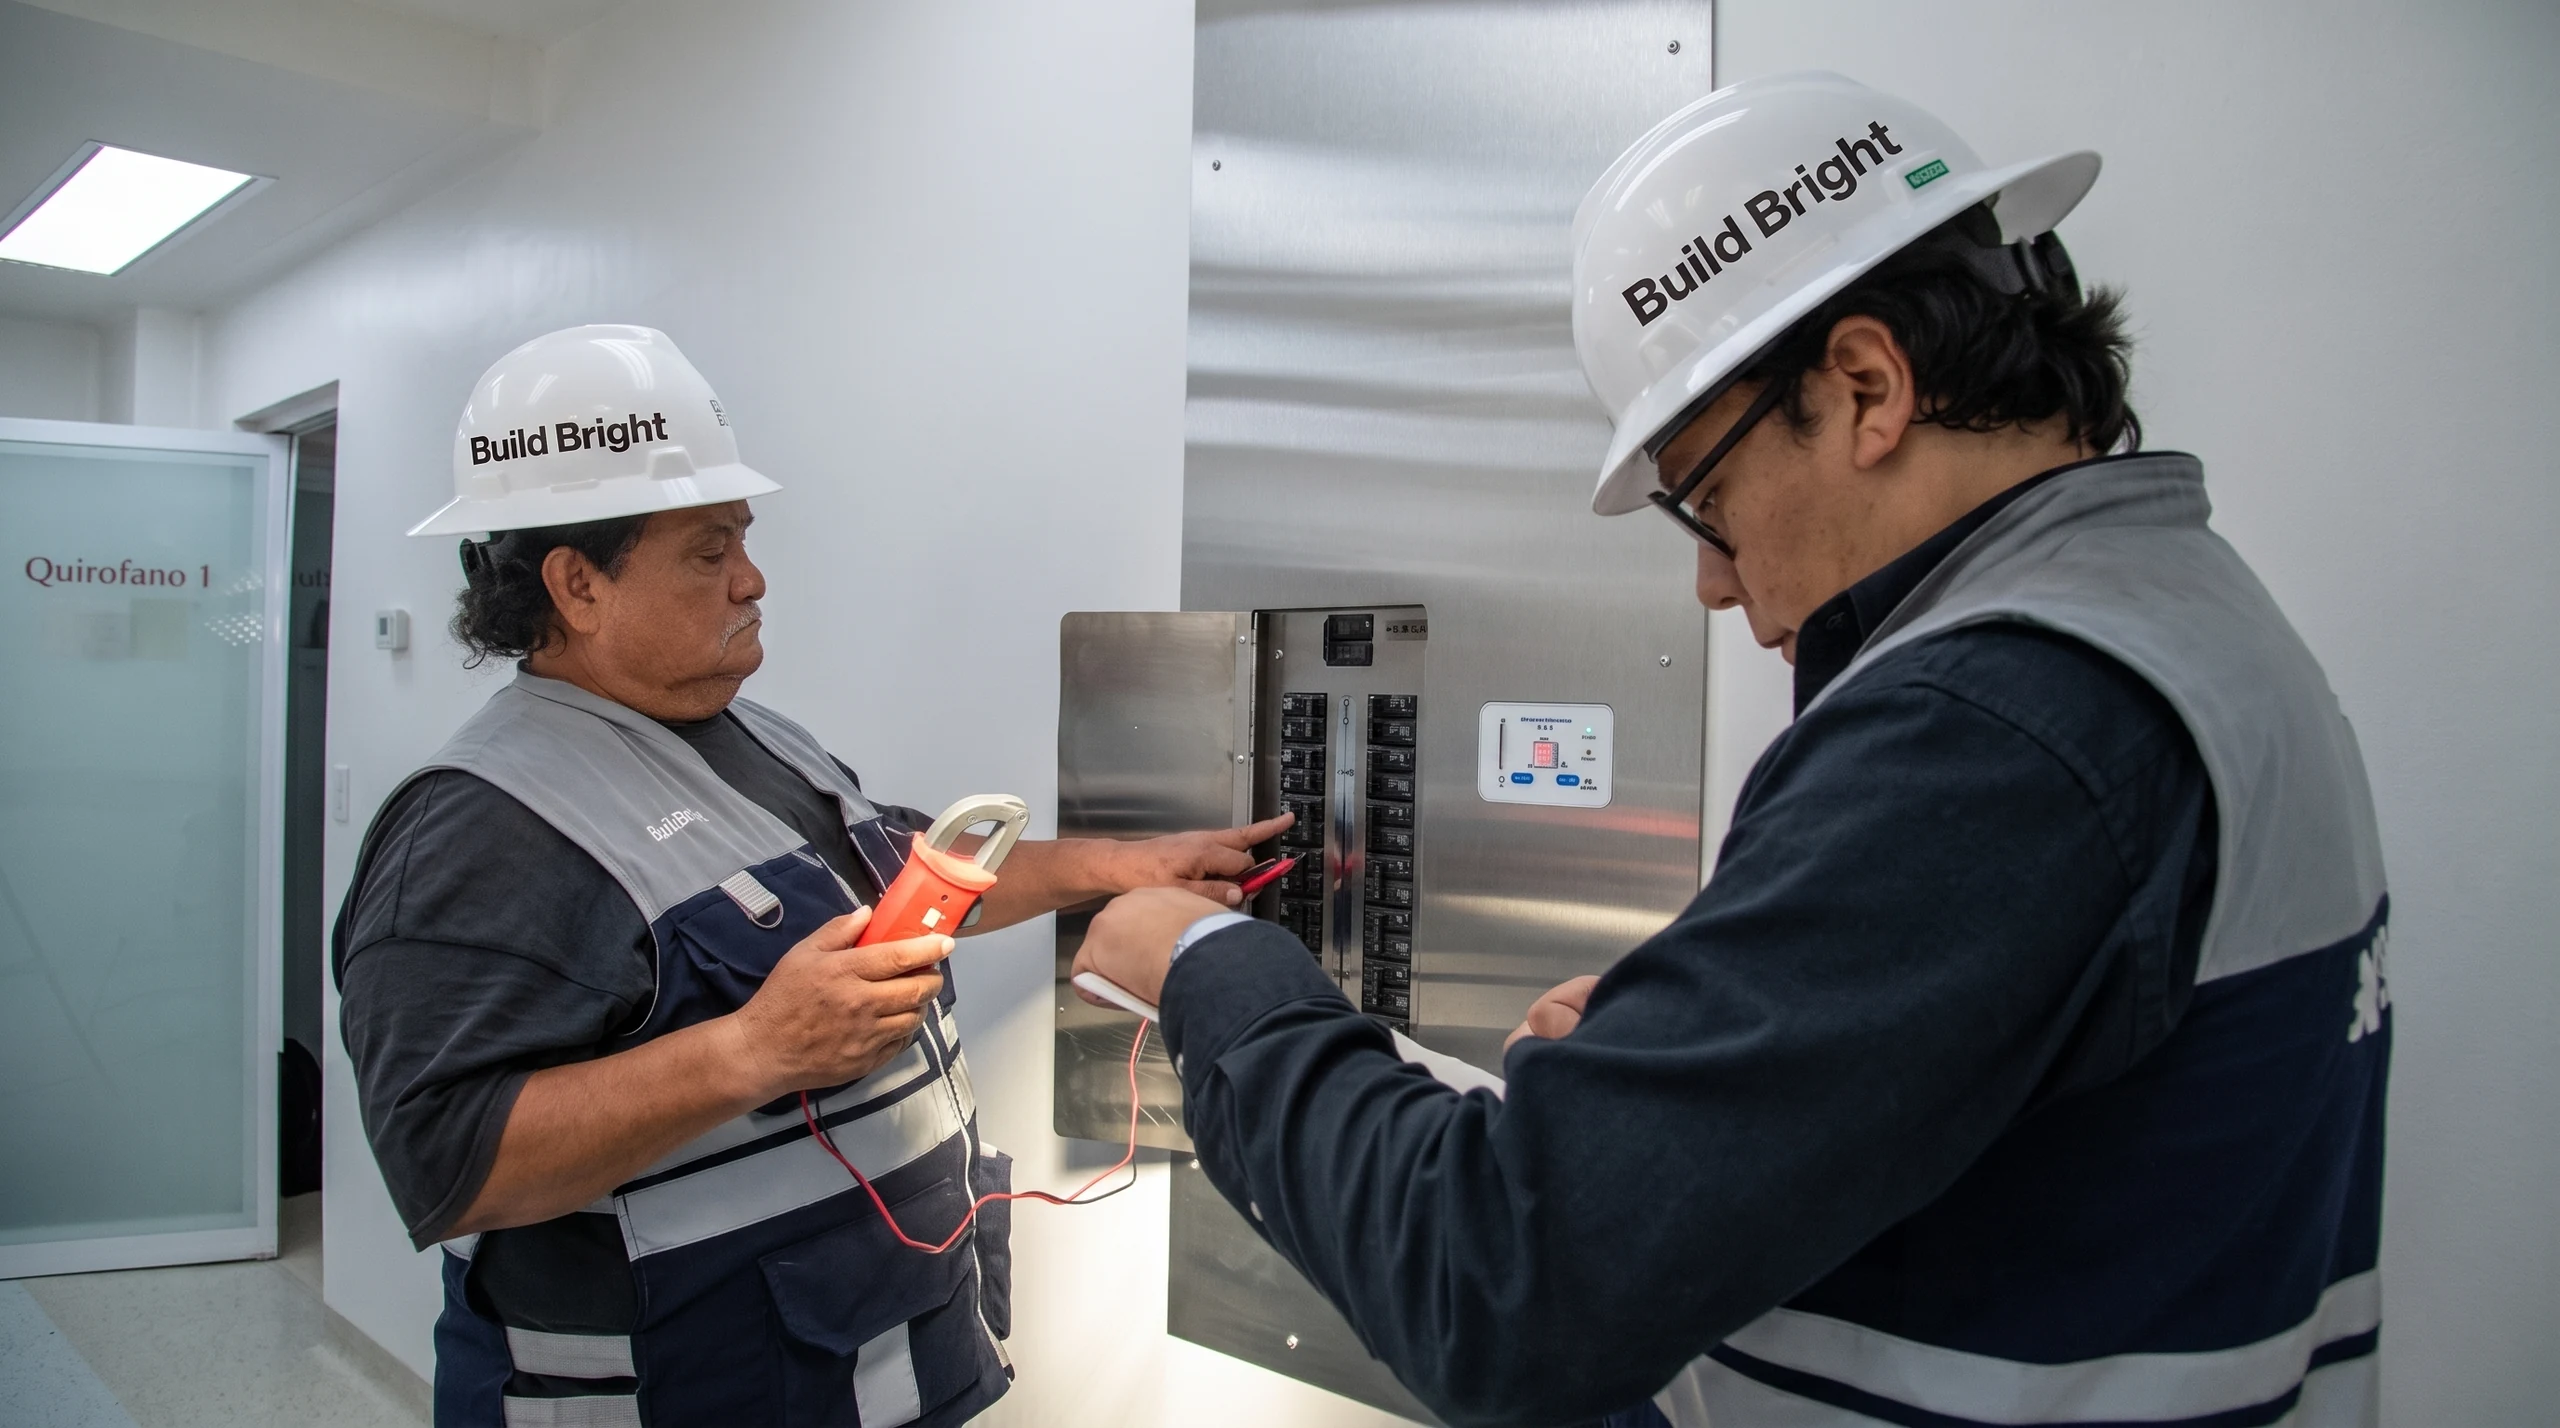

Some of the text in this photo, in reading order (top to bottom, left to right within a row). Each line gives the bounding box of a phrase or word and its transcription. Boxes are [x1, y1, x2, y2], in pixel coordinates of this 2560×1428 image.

[1621, 120, 1904, 327] Build Bright
[470, 424, 549, 466] Build
[555, 412, 669, 453] Bright
[25, 556, 210, 588] Quirofano 1
